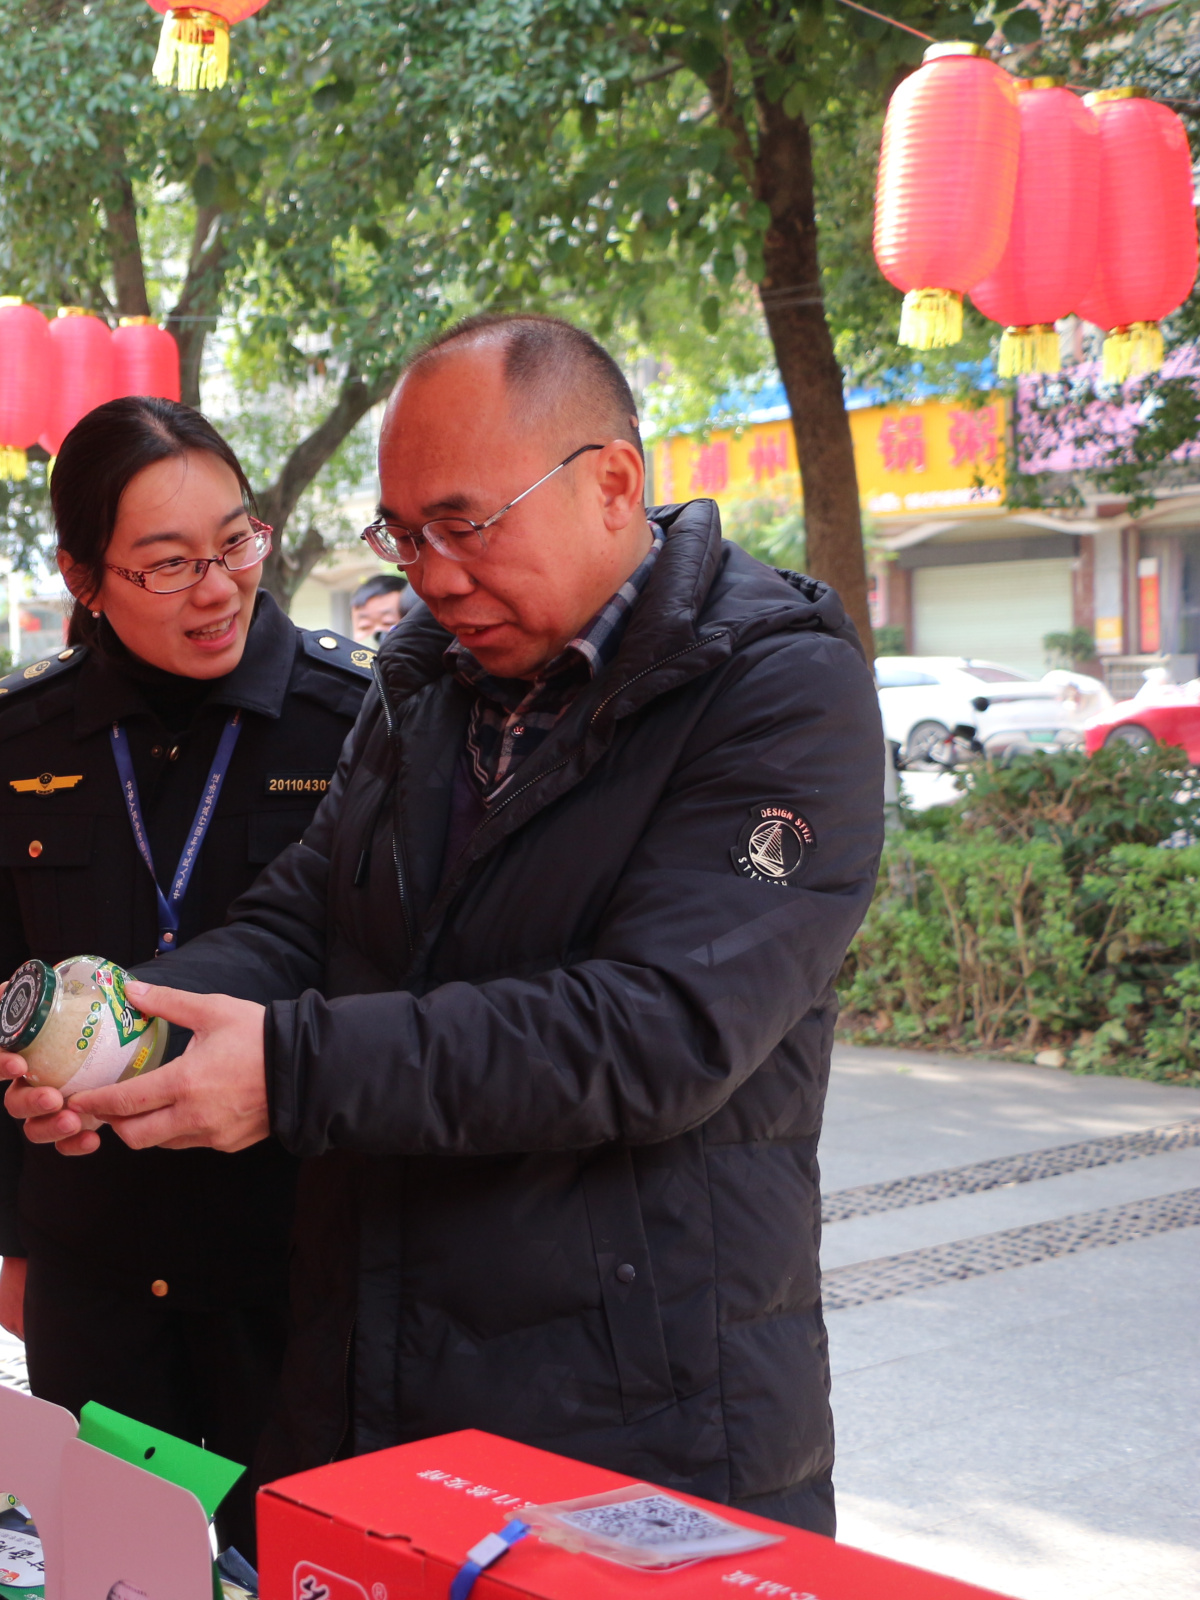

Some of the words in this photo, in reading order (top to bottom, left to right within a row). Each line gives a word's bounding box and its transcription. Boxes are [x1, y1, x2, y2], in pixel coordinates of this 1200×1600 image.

[173, 773, 221, 900] 中华人民共和国行政执法证
[760, 807, 794, 820] DESIGN
[794, 818, 814, 845] STYLE
